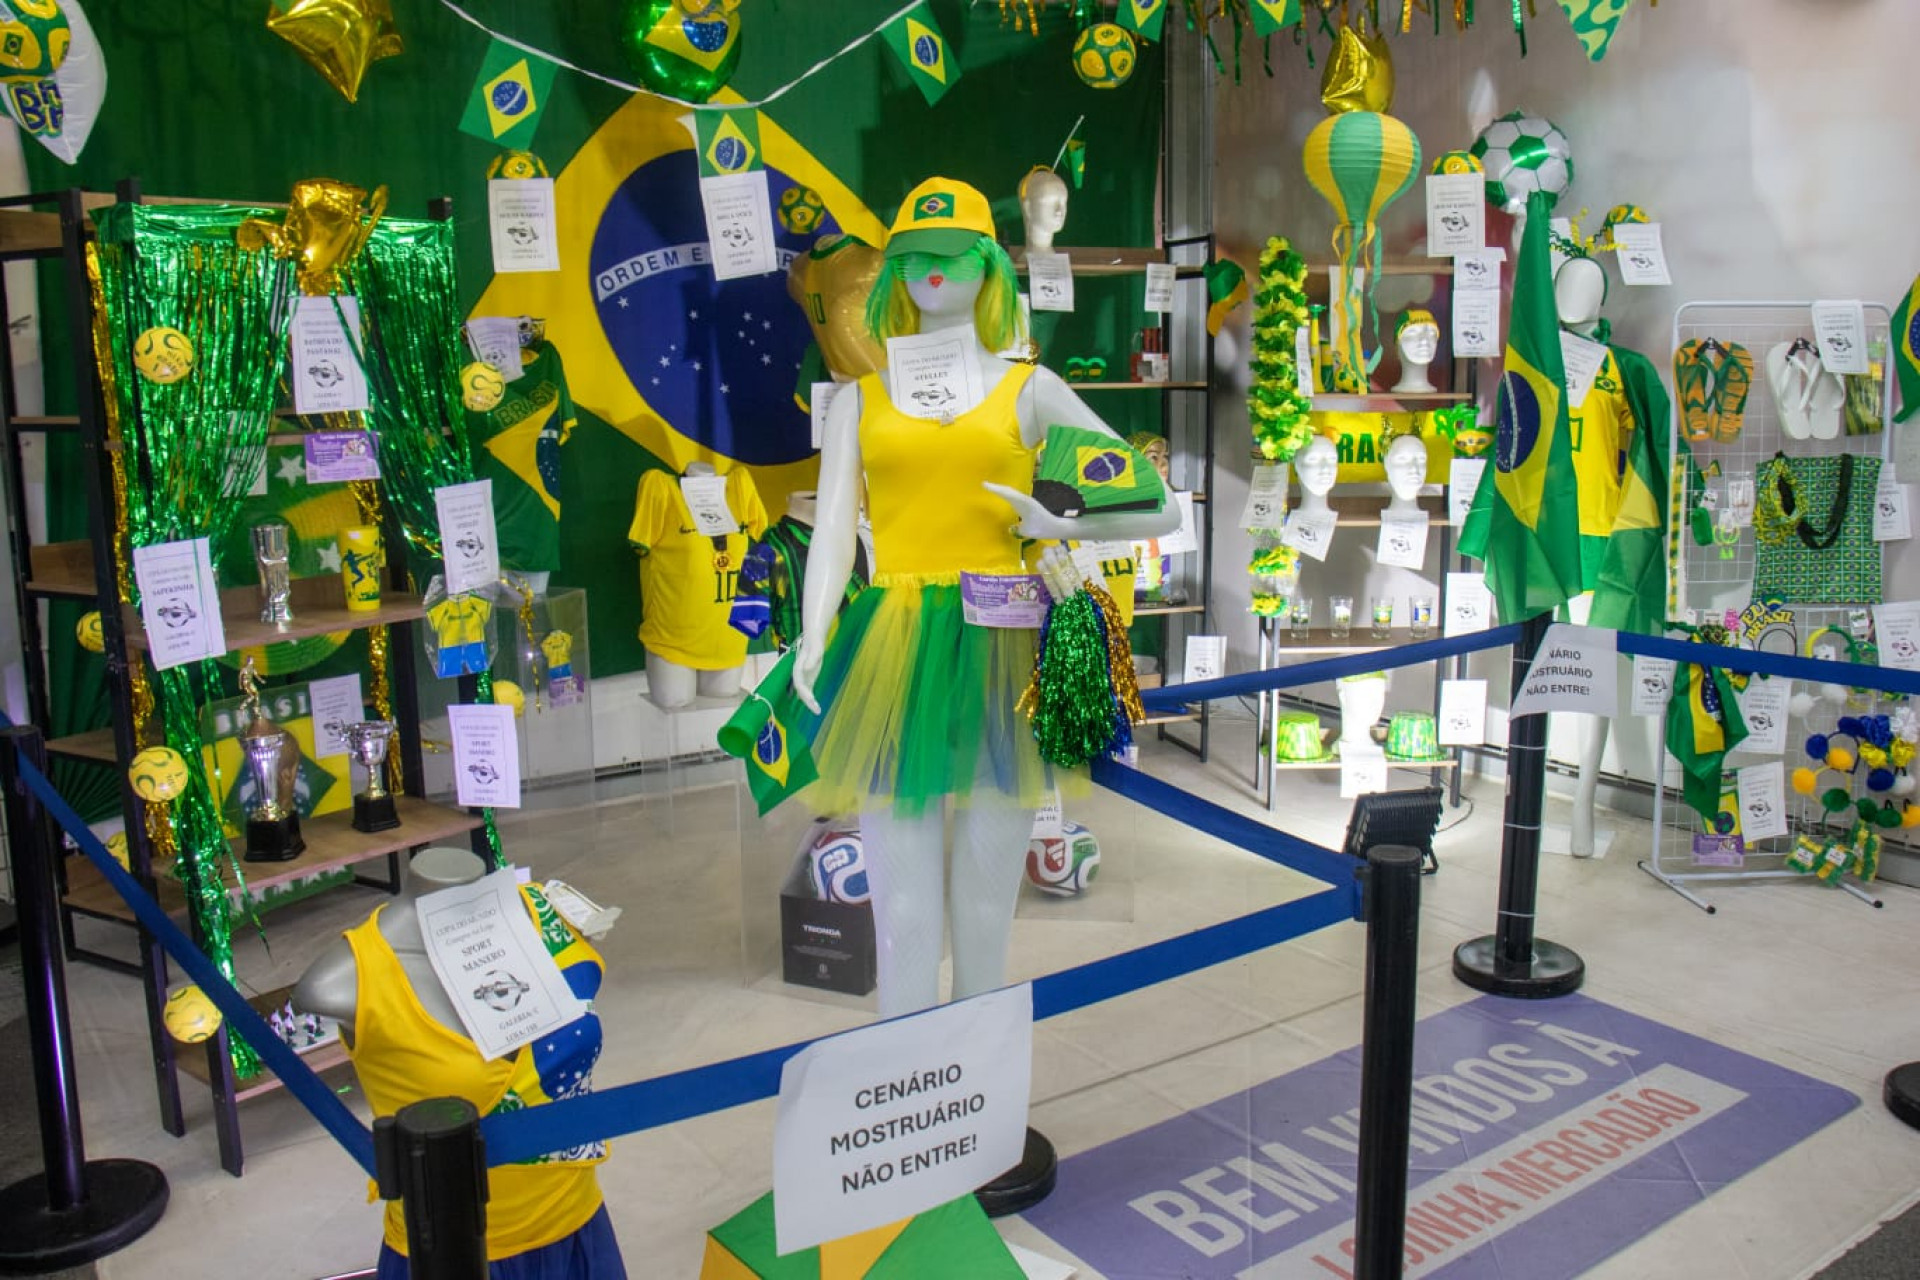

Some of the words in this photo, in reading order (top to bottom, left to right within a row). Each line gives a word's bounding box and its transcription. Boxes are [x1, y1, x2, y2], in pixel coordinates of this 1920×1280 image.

[599, 248, 679, 292] ORDEM
[692, 248, 703, 262] E
[1550, 684, 1590, 697] ENTRE!
[461, 938, 493, 957] SPORT
[462, 949, 507, 971] MANERO
[854, 1063, 963, 1110] CENÁRIO
[830, 1093, 986, 1156] MOSTRUÁRIO
[1484, 1088, 1700, 1202] MERCADÃO
[841, 1162, 895, 1194] NÃO
[900, 1133, 978, 1177] ENTRE!
[1127, 1141, 1357, 1259] BEM
